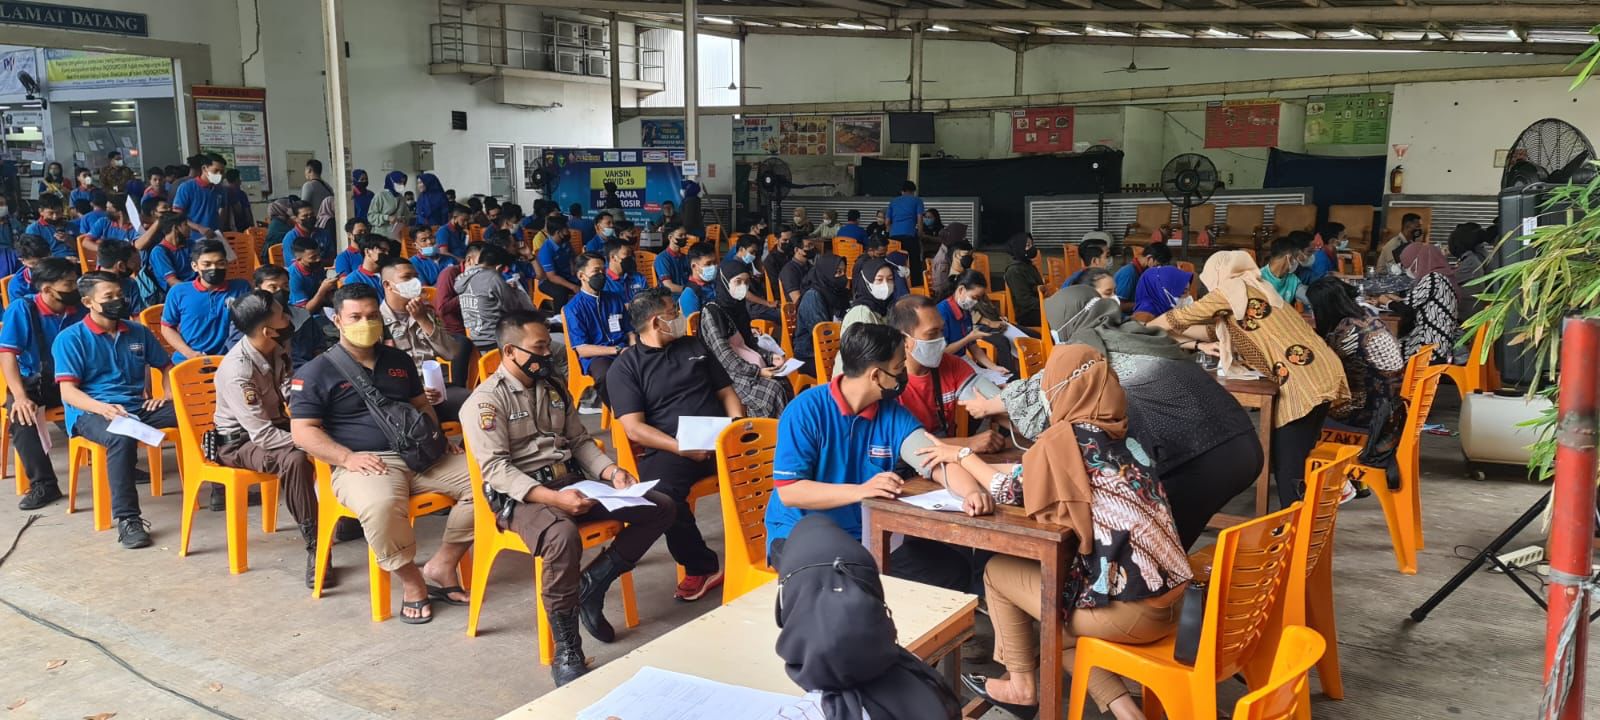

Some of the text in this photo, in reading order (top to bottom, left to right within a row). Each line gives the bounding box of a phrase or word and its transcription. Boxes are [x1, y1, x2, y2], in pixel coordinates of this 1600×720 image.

[0, 6, 138, 31] LAMAT DATANG
[605, 169, 631, 178] VAKSIN
[599, 190, 638, 199] BSAMA
[1321, 430, 1361, 445] ZAKY
[1311, 460, 1367, 480] DKY
